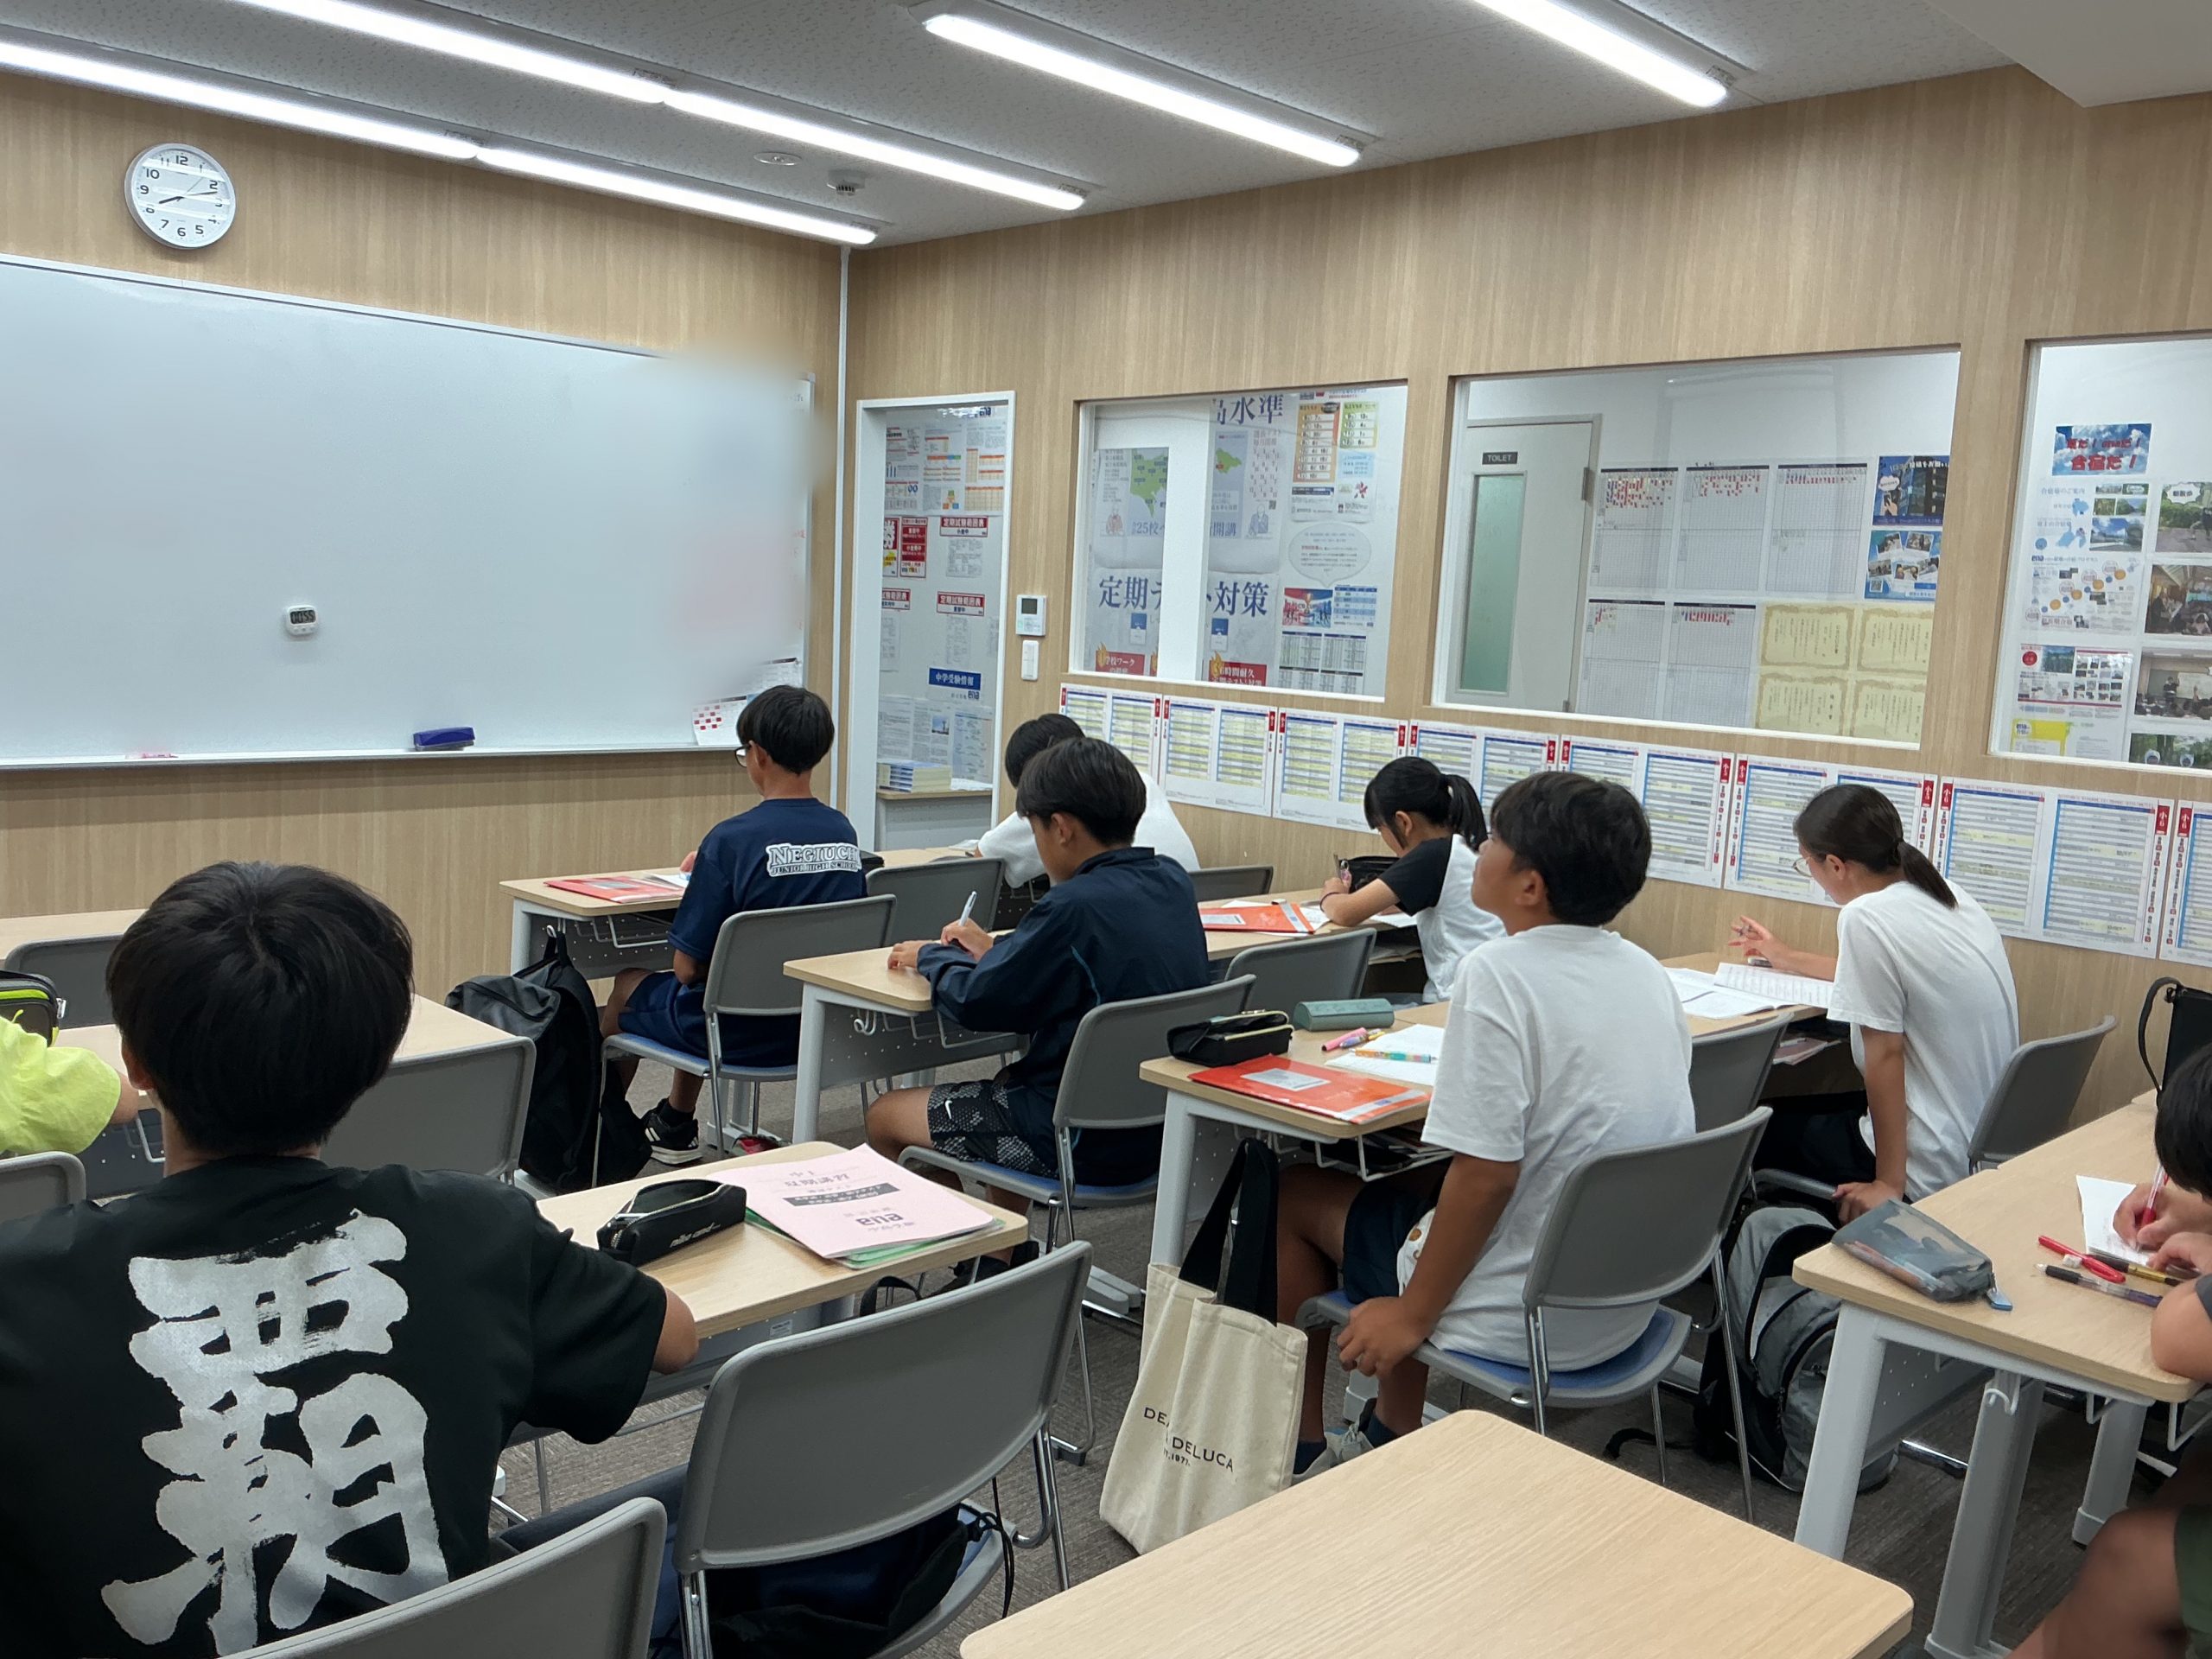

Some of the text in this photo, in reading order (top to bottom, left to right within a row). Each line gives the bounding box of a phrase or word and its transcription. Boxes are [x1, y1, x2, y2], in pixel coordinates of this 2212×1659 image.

[175, 155, 188, 166] 12
[146, 168, 160, 180] 10
[140, 184, 149, 194] 9
[209, 179, 218, 190] 2
[161, 219, 169, 229] 7
[176, 227, 187, 237] 6
[194, 225, 204, 235] 5
[1206, 581, 1269, 618] 対策
[935, 671, 975, 686] 中学受験情報
[807, 863, 830, 872] HIGH
[855, 1212, 904, 1226] ena
[1143, 1407, 1170, 1428] DE
[1172, 1436, 1234, 1473] DELUCA
